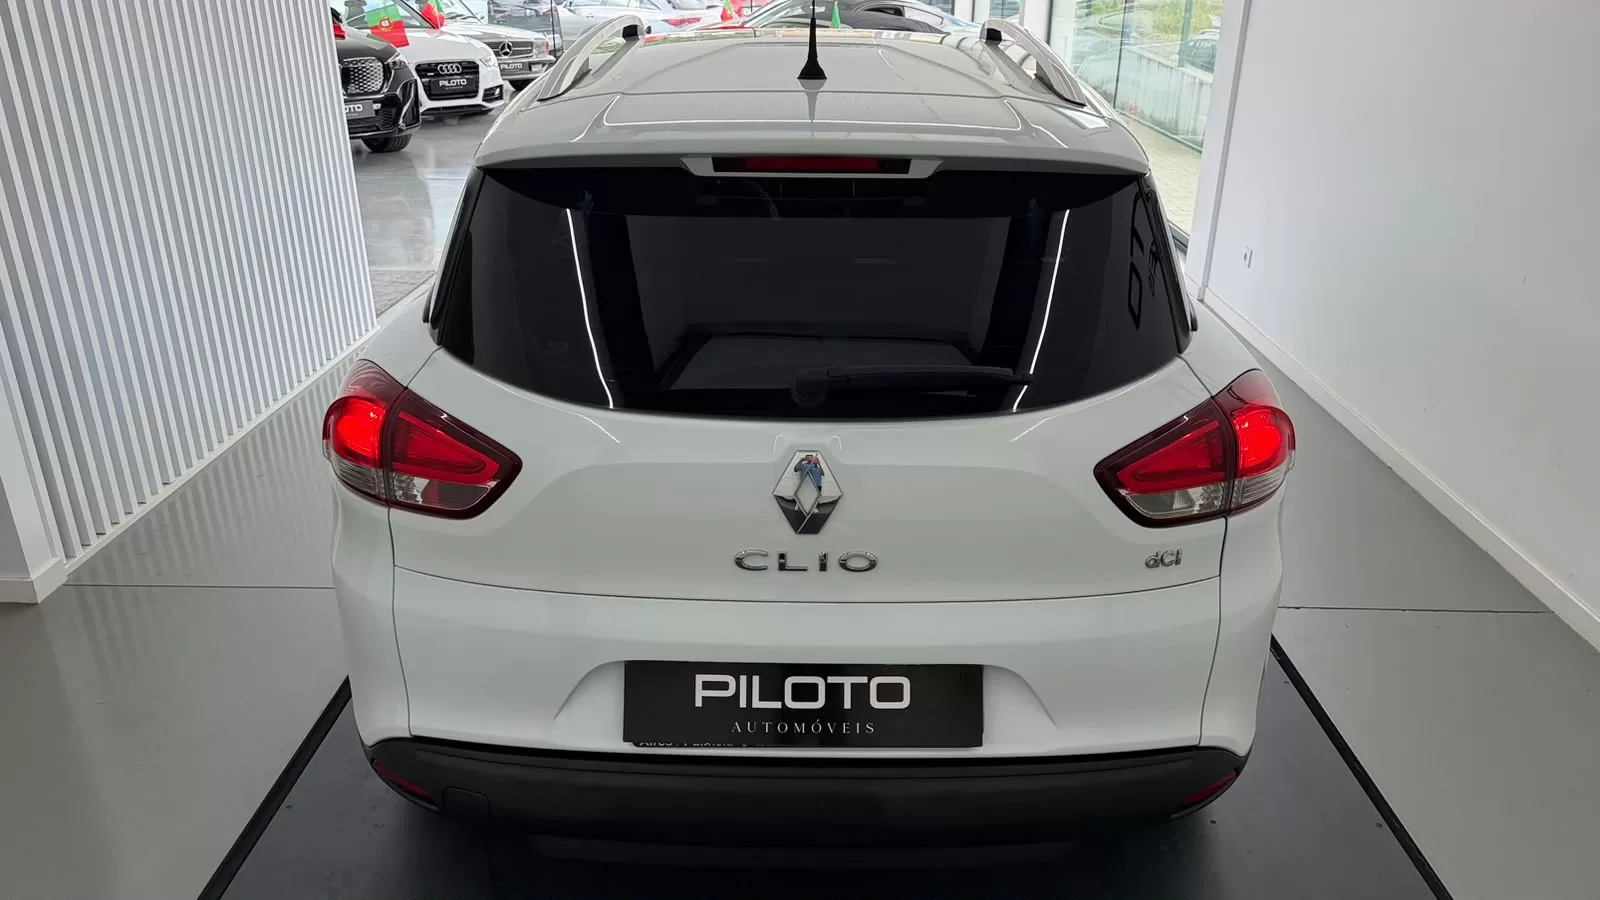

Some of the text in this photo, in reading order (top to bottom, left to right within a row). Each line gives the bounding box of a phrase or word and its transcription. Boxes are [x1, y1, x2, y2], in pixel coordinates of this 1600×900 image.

[439, 78, 467, 87] PILOTO
[733, 549, 878, 573] CLIO
[695, 674, 911, 710] PILOTO
[731, 718, 876, 734] AUTOMÓVEIS
